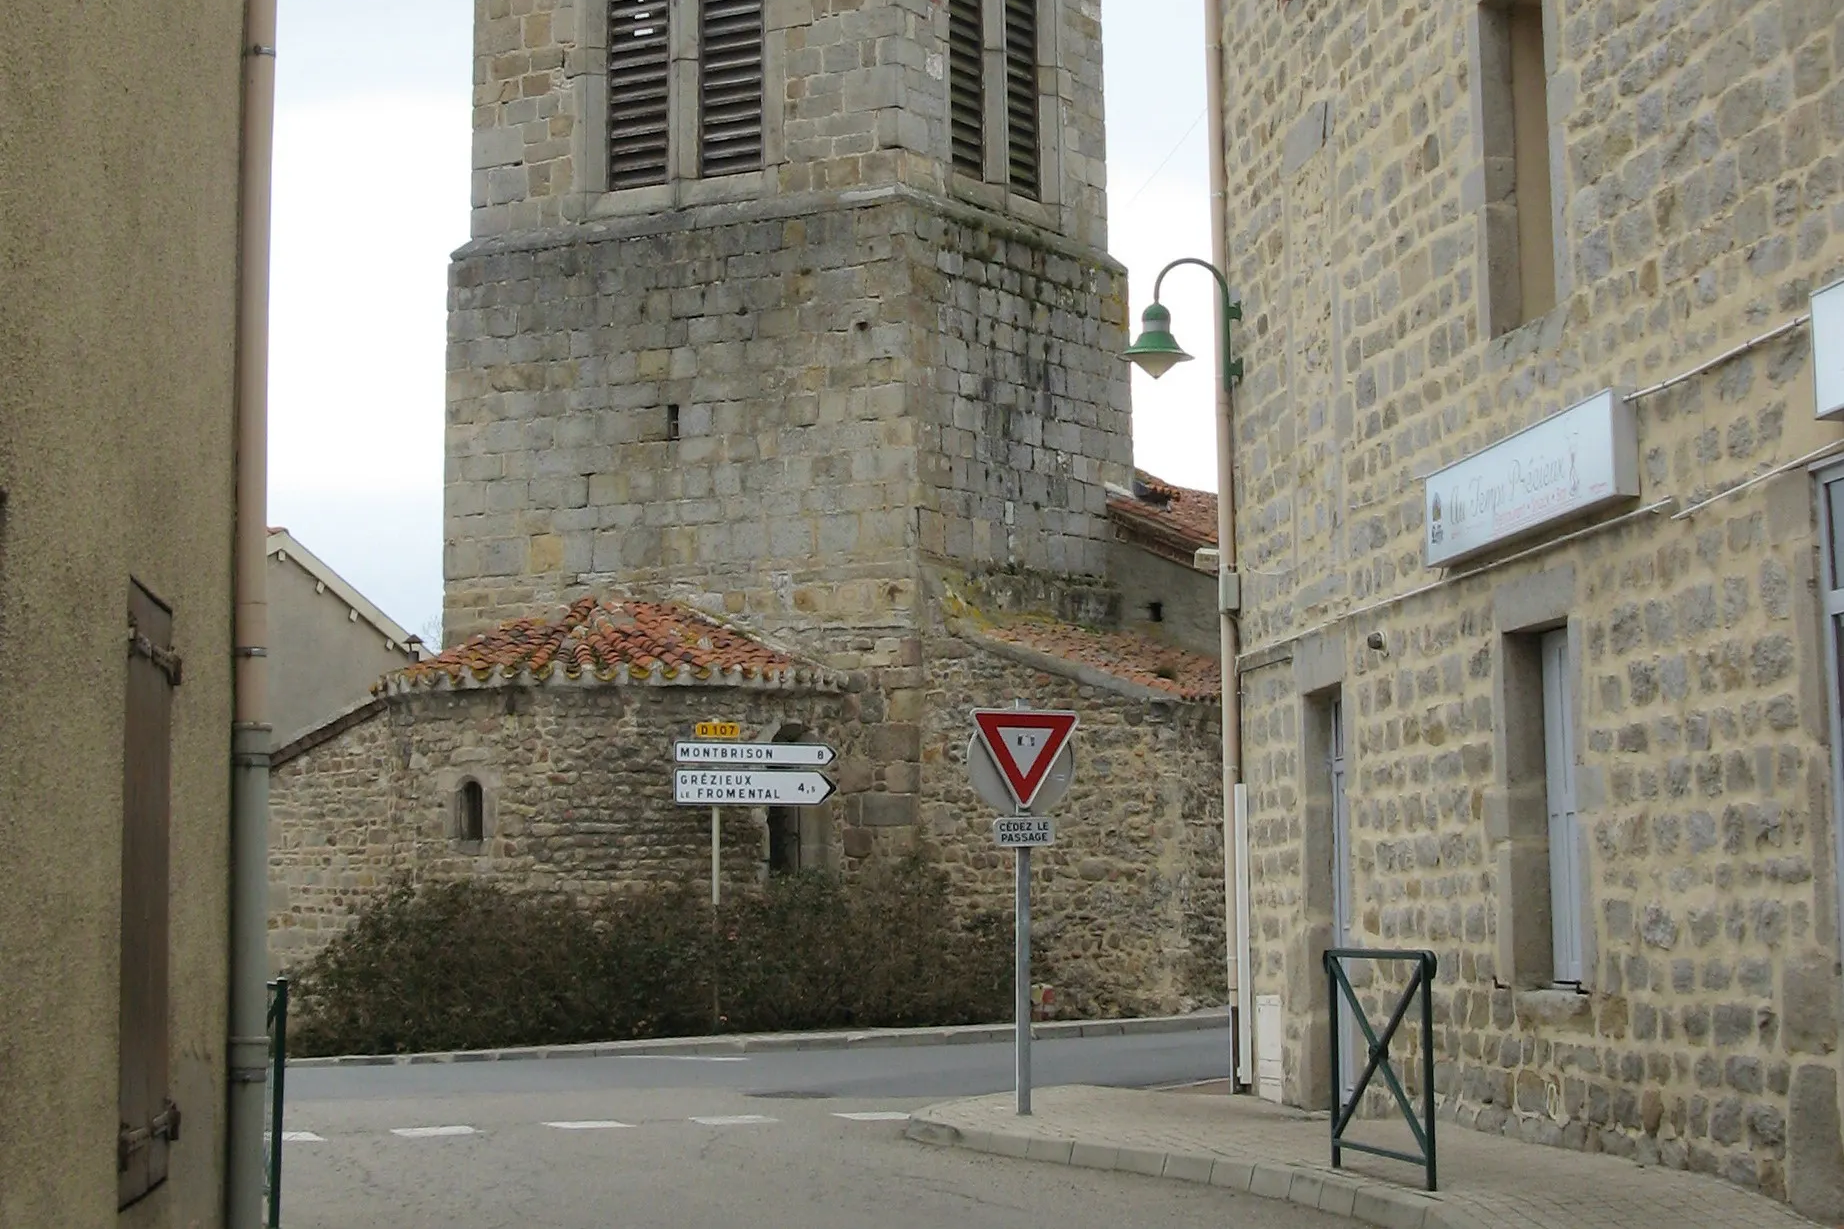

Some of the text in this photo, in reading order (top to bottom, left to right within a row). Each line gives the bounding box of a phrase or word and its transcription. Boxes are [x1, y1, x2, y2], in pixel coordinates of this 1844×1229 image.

[701, 725, 736, 735] D 107
[680, 747, 824, 760] MONTBRISON 8
[680, 773, 752, 786] GRÉZIEUX
[680, 788, 781, 799] LE FROMENTAL
[1000, 822, 1048, 831] CÉDEZ LE
[1002, 833, 1047, 842] PASSAGE
